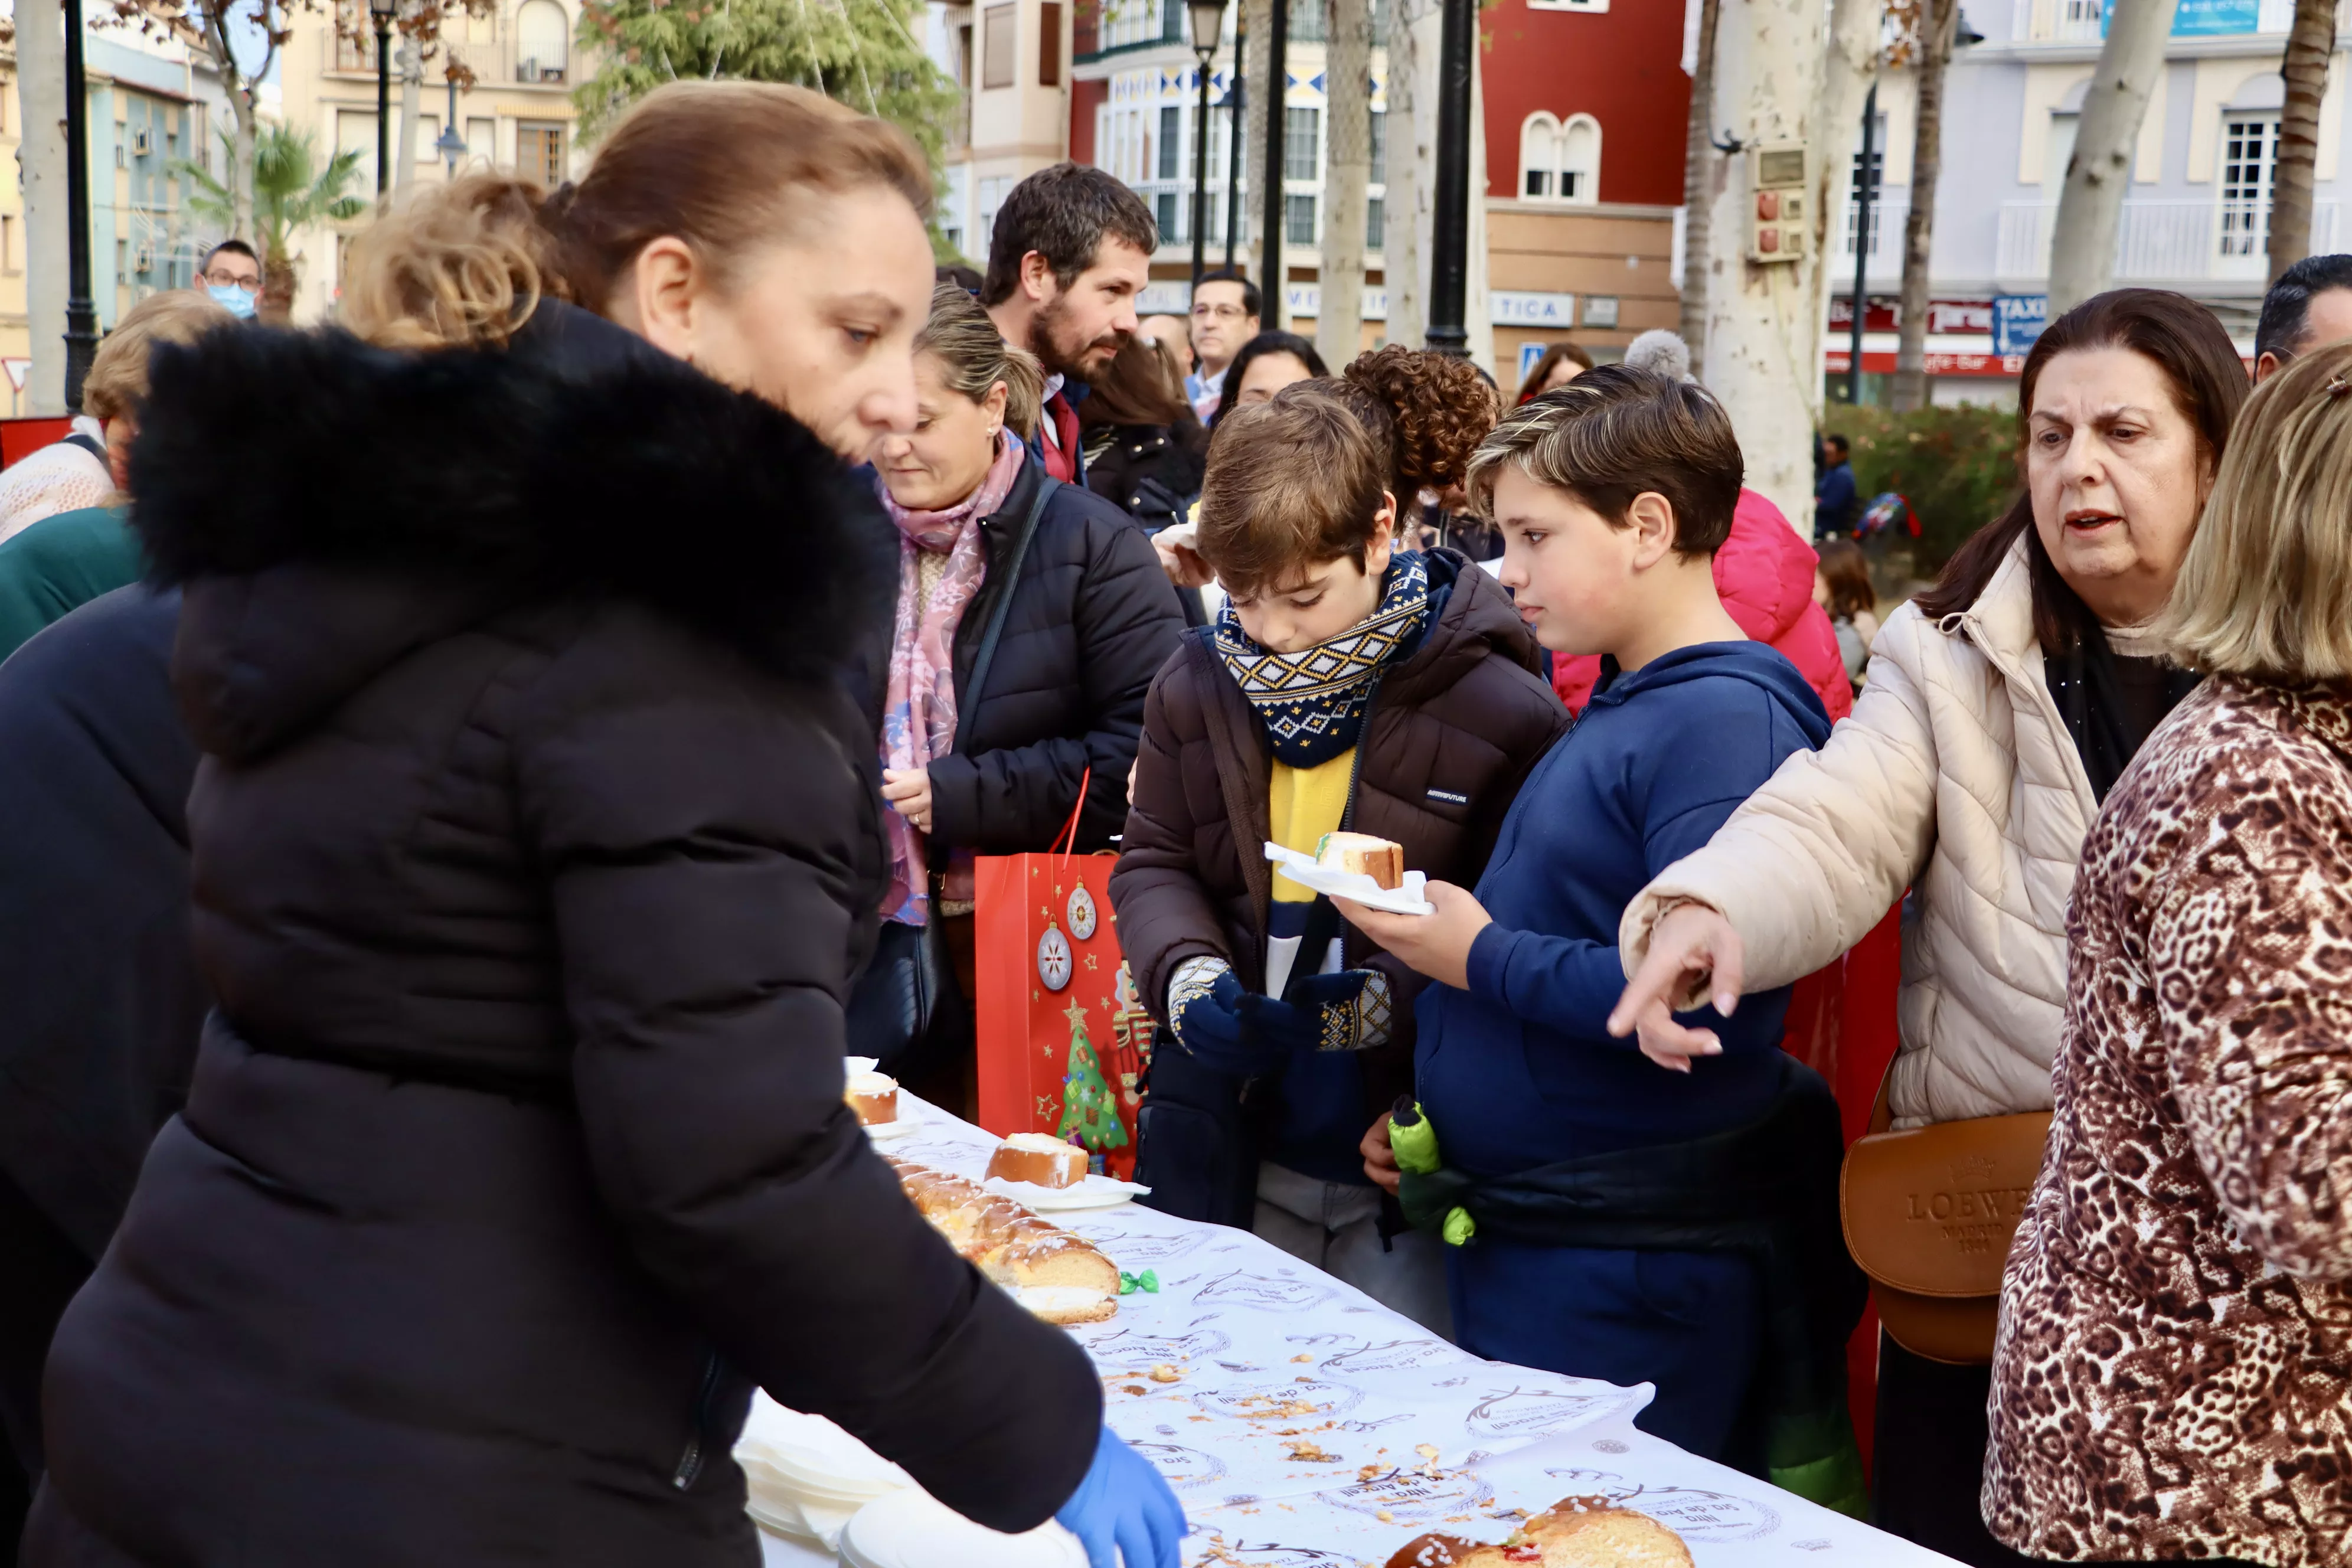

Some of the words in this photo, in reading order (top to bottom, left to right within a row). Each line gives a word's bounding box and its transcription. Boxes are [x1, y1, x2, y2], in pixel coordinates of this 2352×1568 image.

[1907, 1188, 2028, 1222] LOEWE
[1398, 1357, 1416, 1367] de
[1341, 1364, 1394, 1373] Araceli
[1276, 1390, 1298, 1398] de
[1490, 1415, 1546, 1430] Araceli
[1340, 1483, 1397, 1497] Araceli
[1390, 1488, 1432, 1498] Ntra.
[1680, 1514, 1721, 1523] Ntra.
